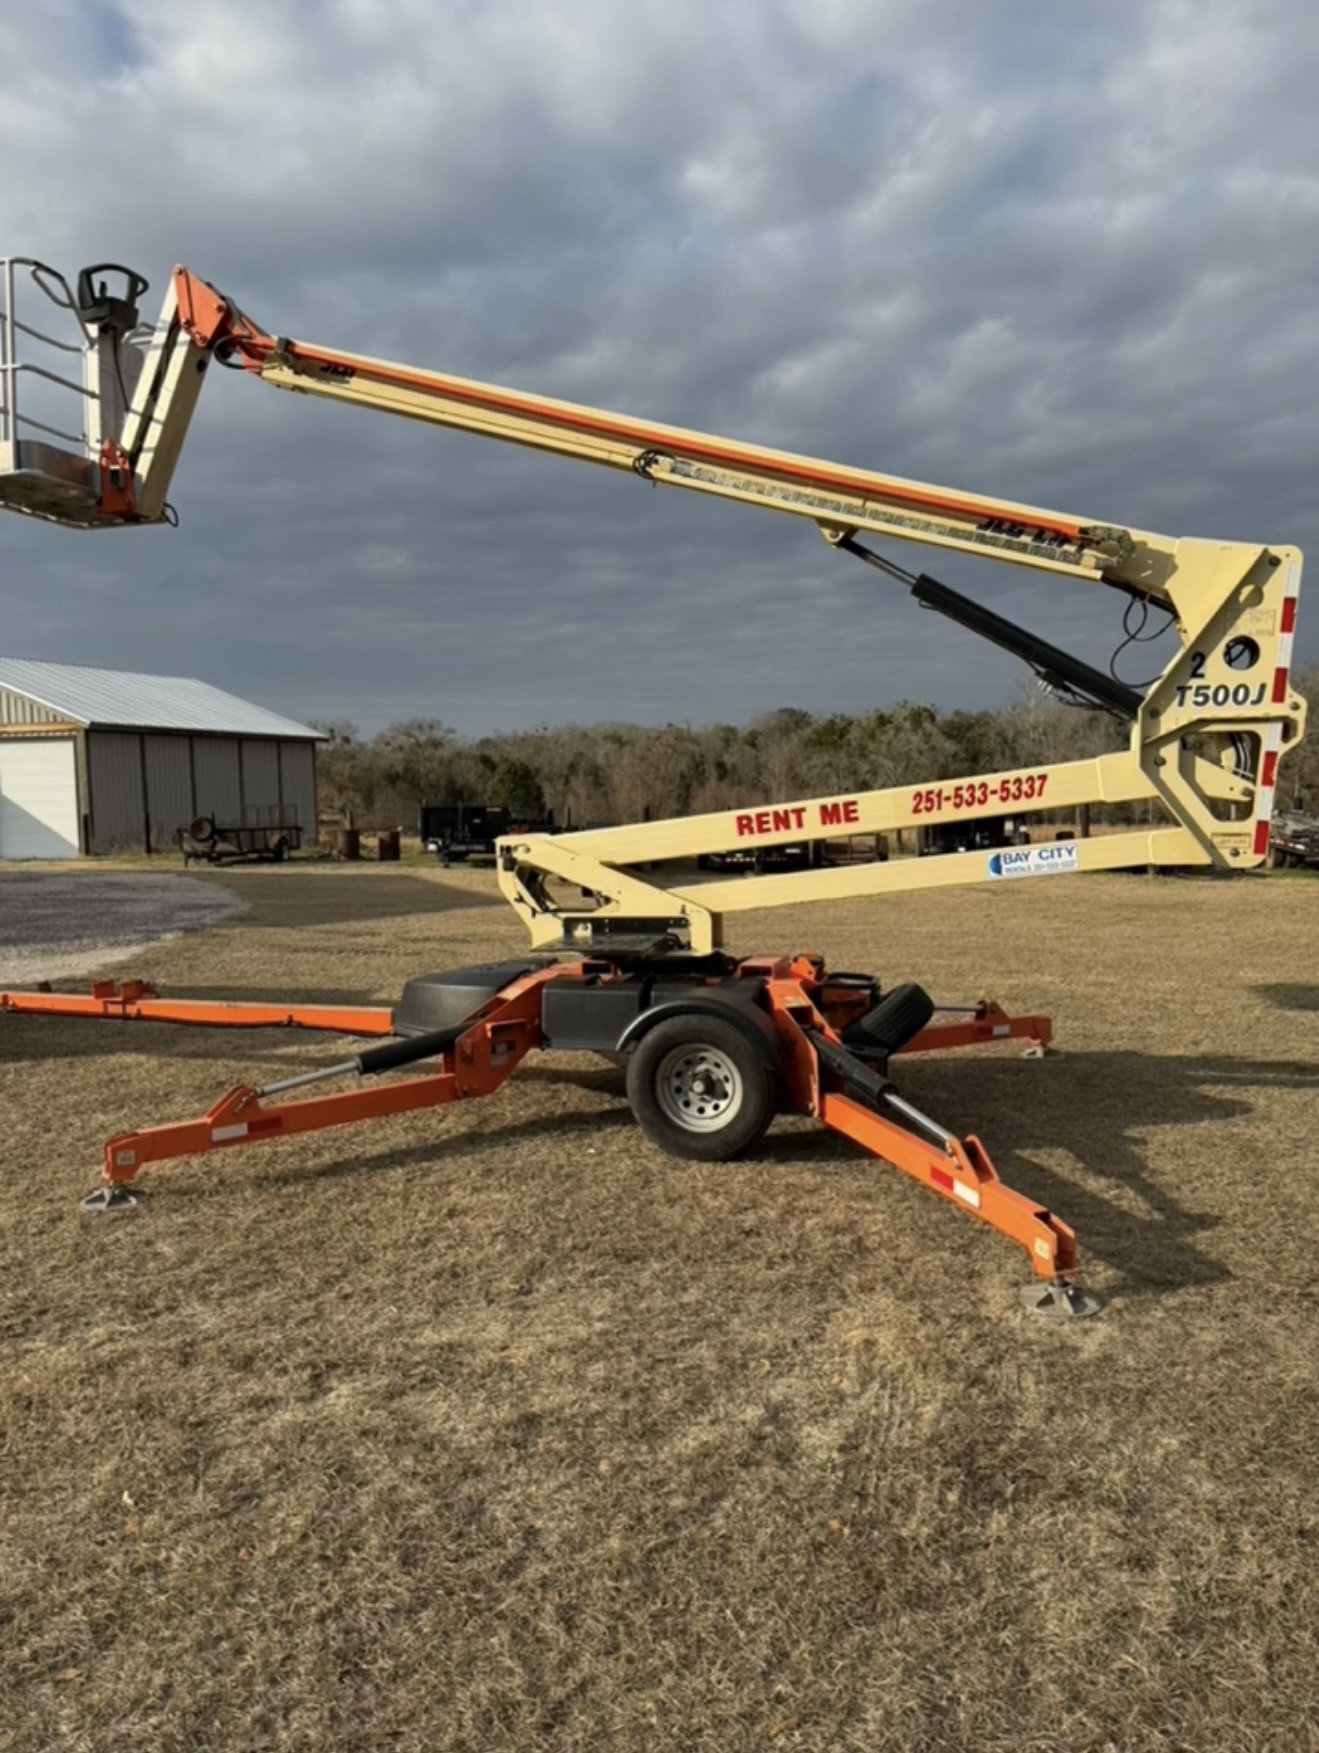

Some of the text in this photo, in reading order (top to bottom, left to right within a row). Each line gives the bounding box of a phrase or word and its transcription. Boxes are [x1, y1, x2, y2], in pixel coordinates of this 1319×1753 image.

[1190, 651, 1206, 678] 2
[1175, 682, 1267, 708] T500J
[911, 774, 1048, 815] 251-533-5337
[736, 800, 860, 837] RENT ME
[1002, 846, 1075, 865] BAY CITY
